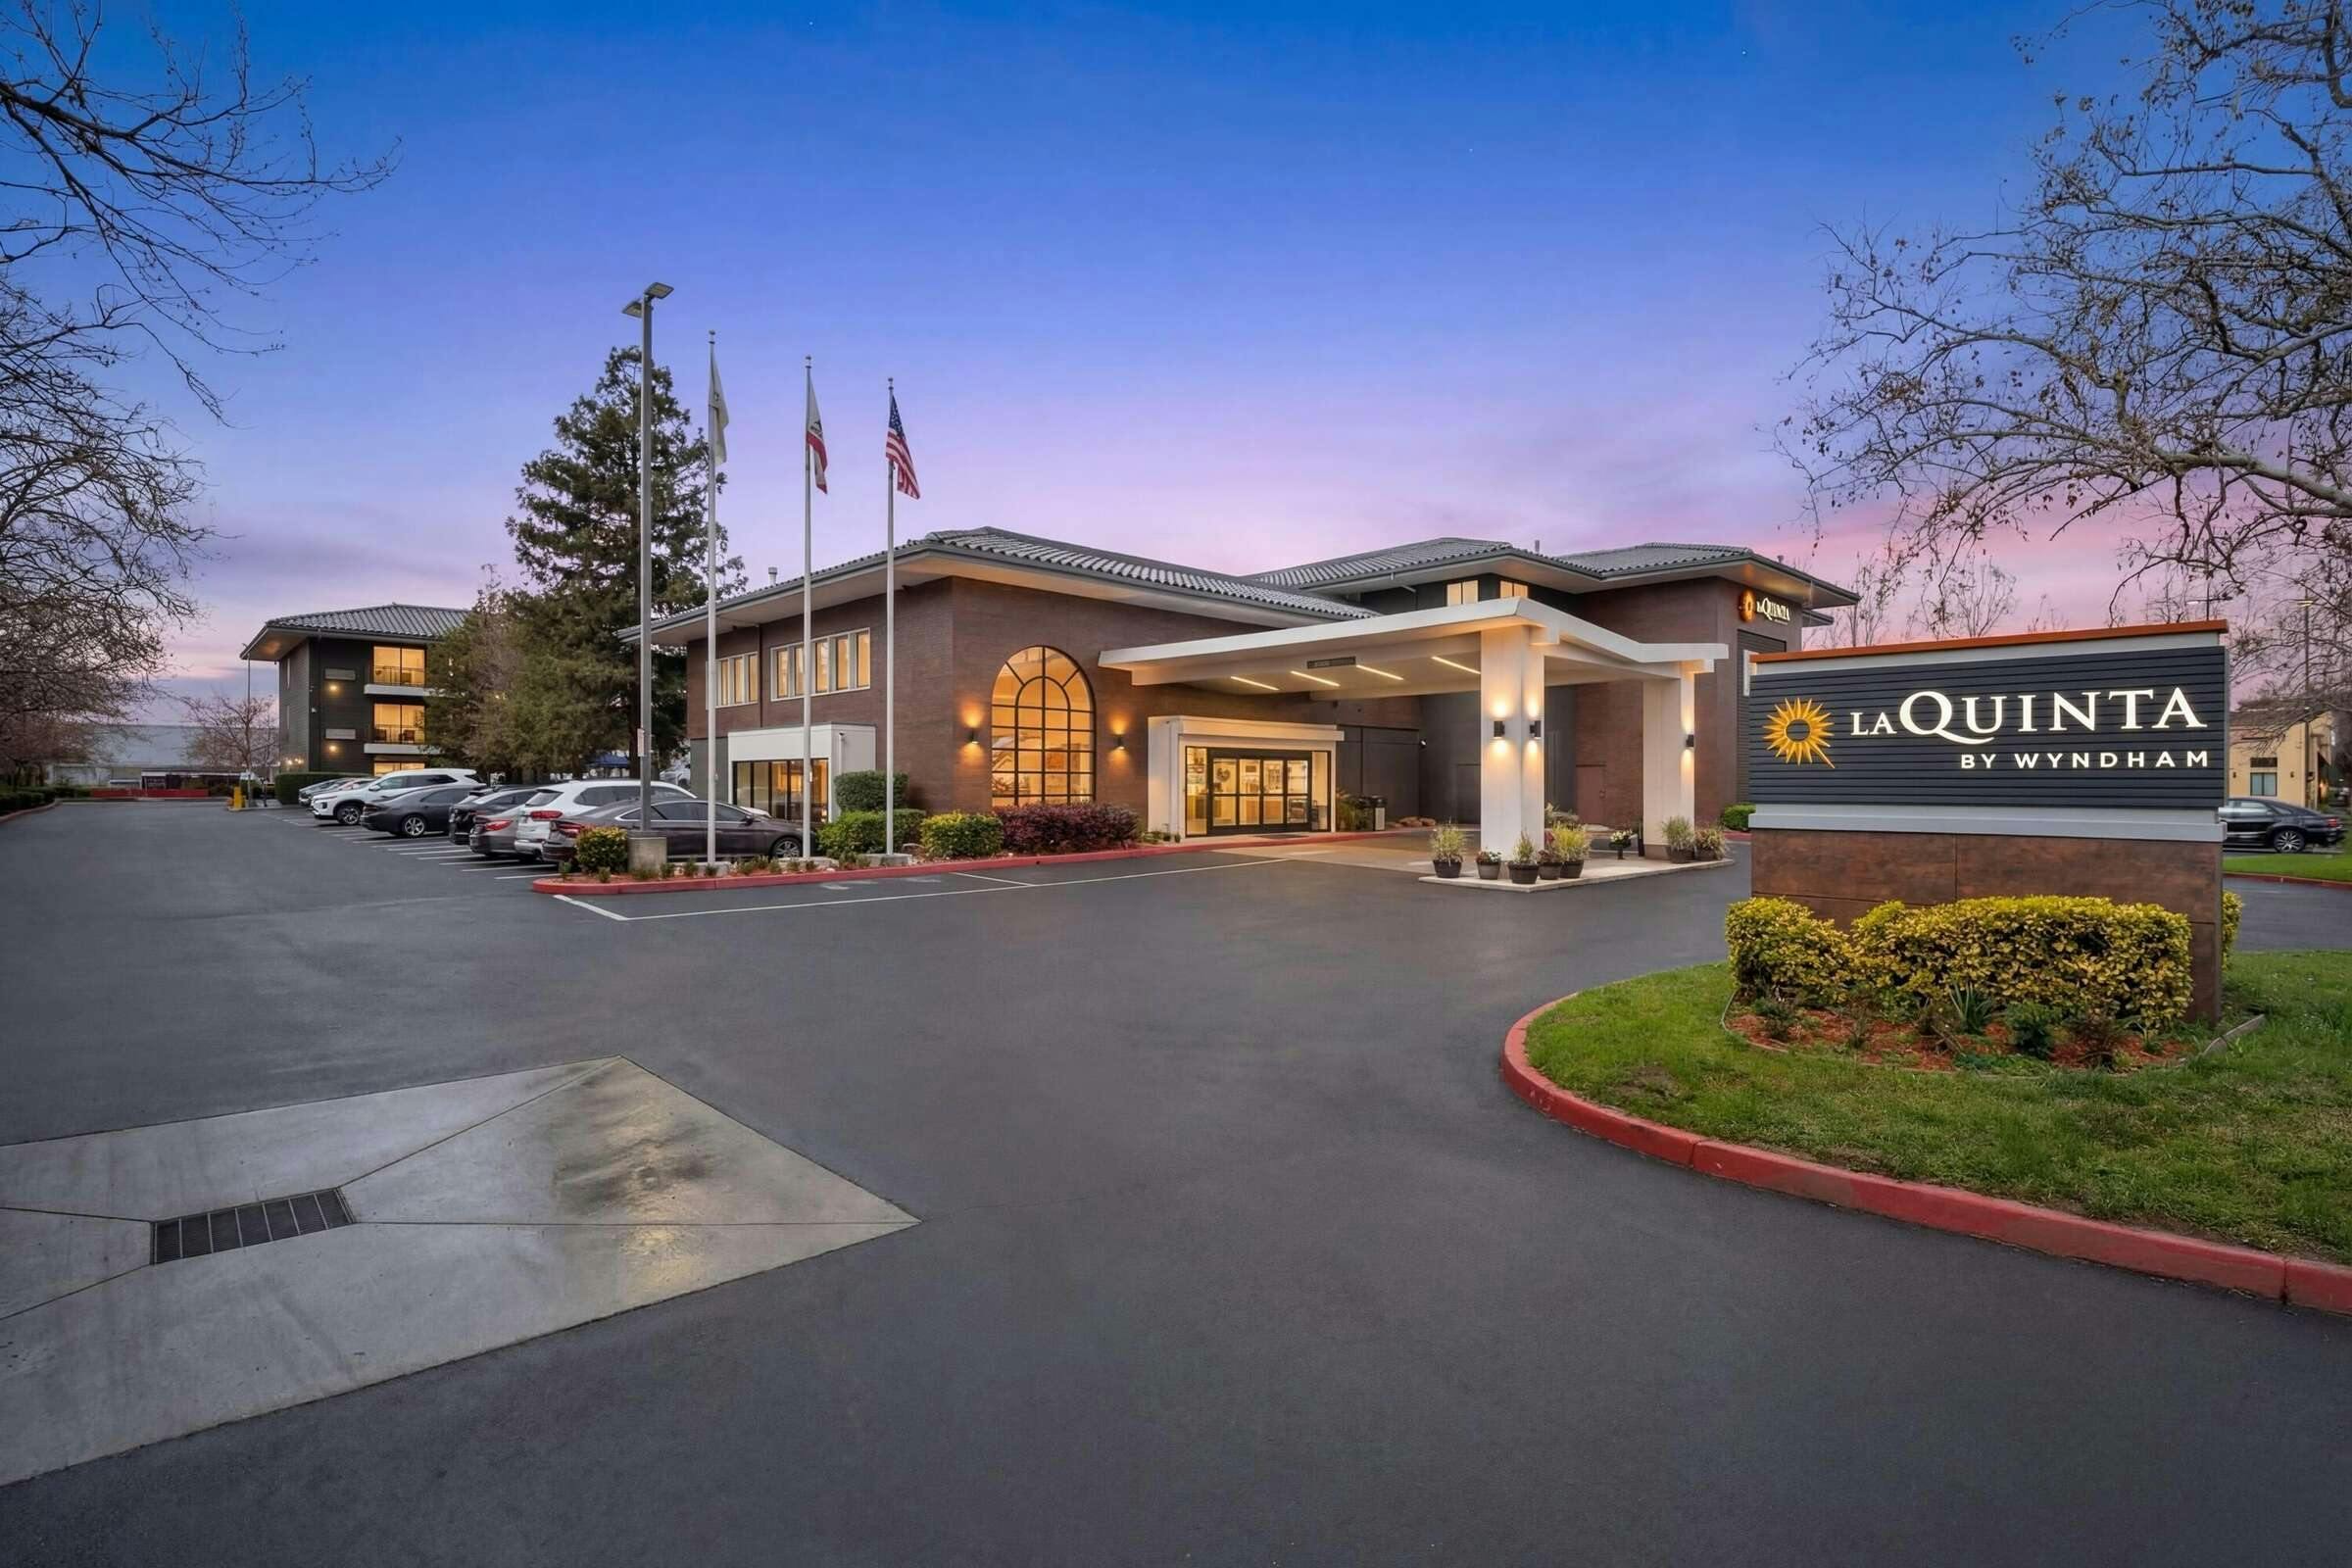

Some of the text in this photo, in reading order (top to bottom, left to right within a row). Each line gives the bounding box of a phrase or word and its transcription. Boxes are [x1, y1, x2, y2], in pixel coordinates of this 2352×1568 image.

[1850, 686, 2208, 745] LA QUINTA
[1961, 750, 2208, 769] BY WYNDHAM
